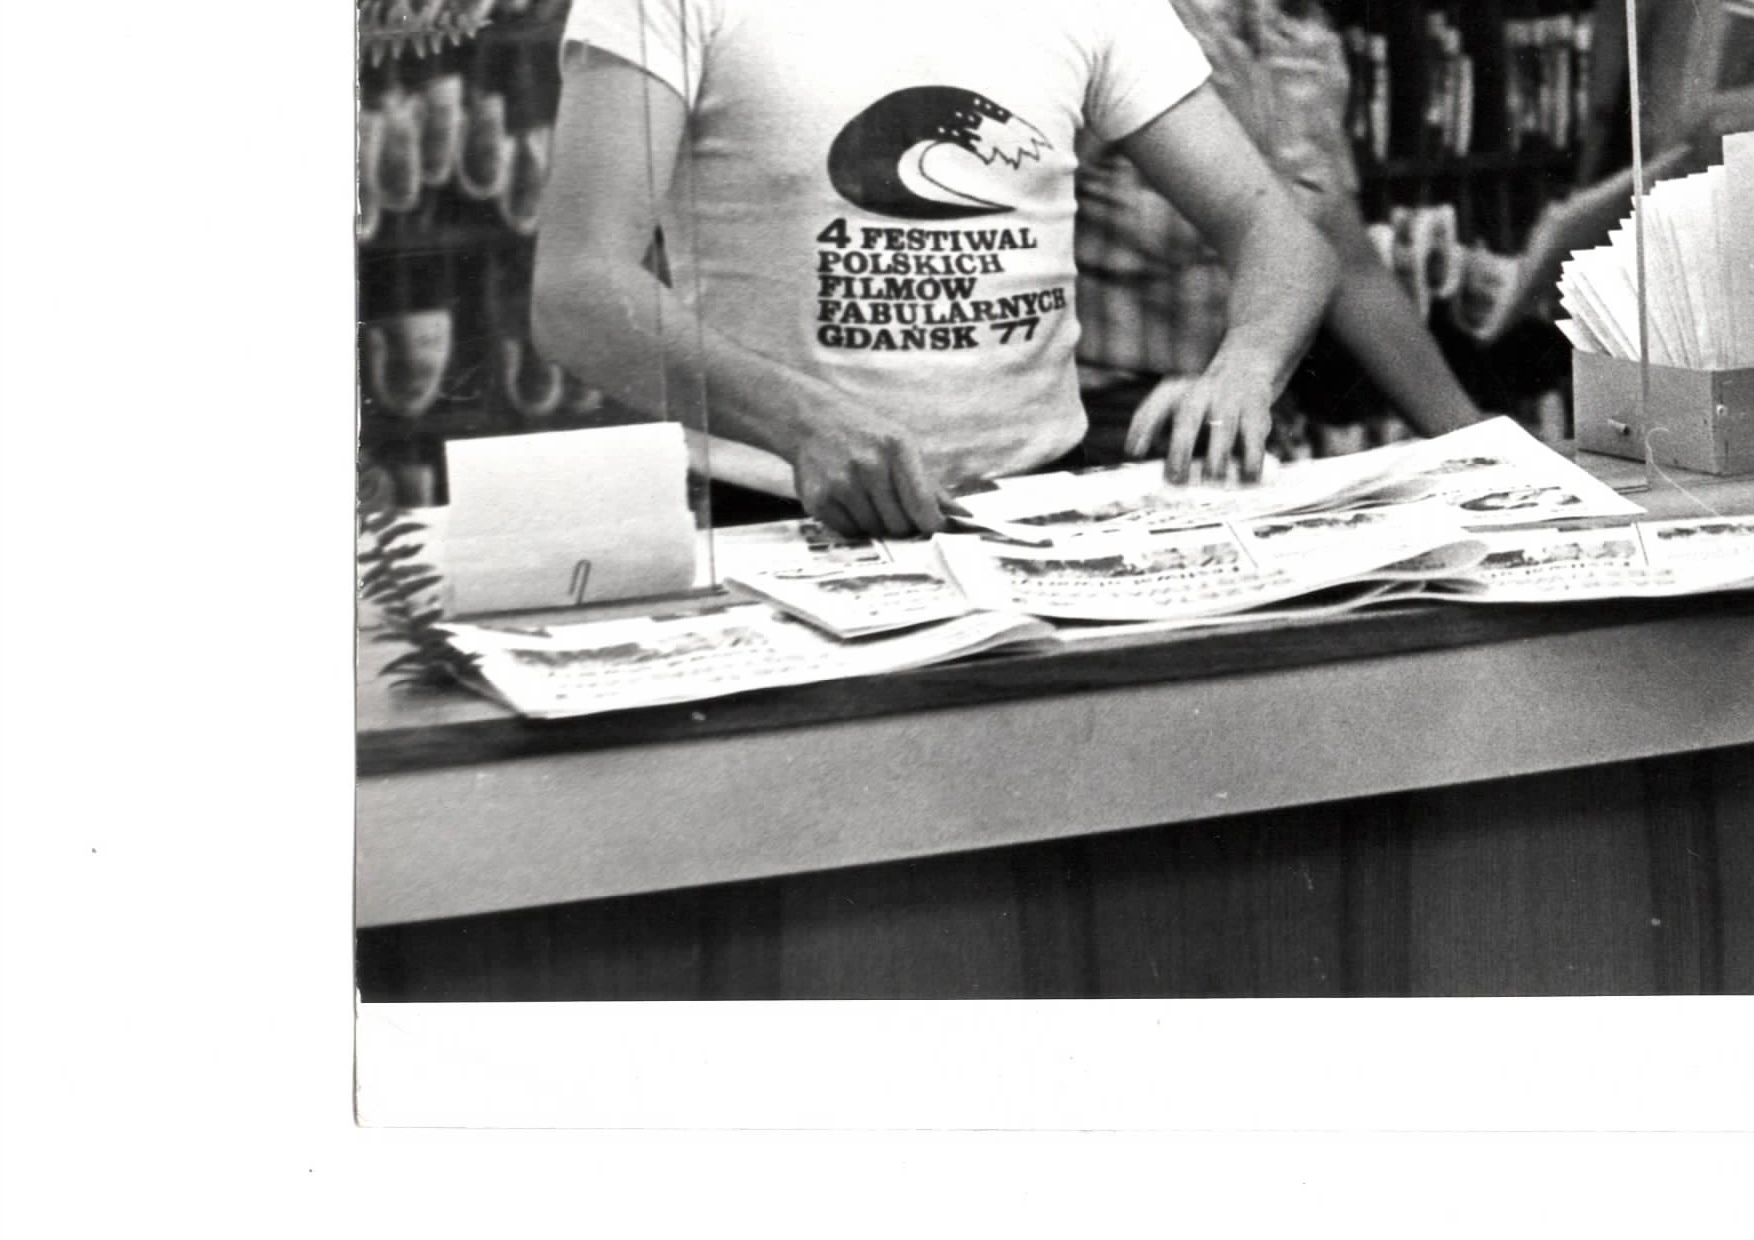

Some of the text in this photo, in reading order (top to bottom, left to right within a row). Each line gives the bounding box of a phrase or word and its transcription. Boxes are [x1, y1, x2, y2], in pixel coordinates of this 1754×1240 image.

[816, 217, 1038, 251] 4 FESTIWAL
[817, 249, 1005, 275] POLSKICH
[817, 275, 978, 301] FILMÓW
[817, 287, 1067, 324] FABULARNYCH
[816, 315, 1040, 351] GDAŃSK 77
